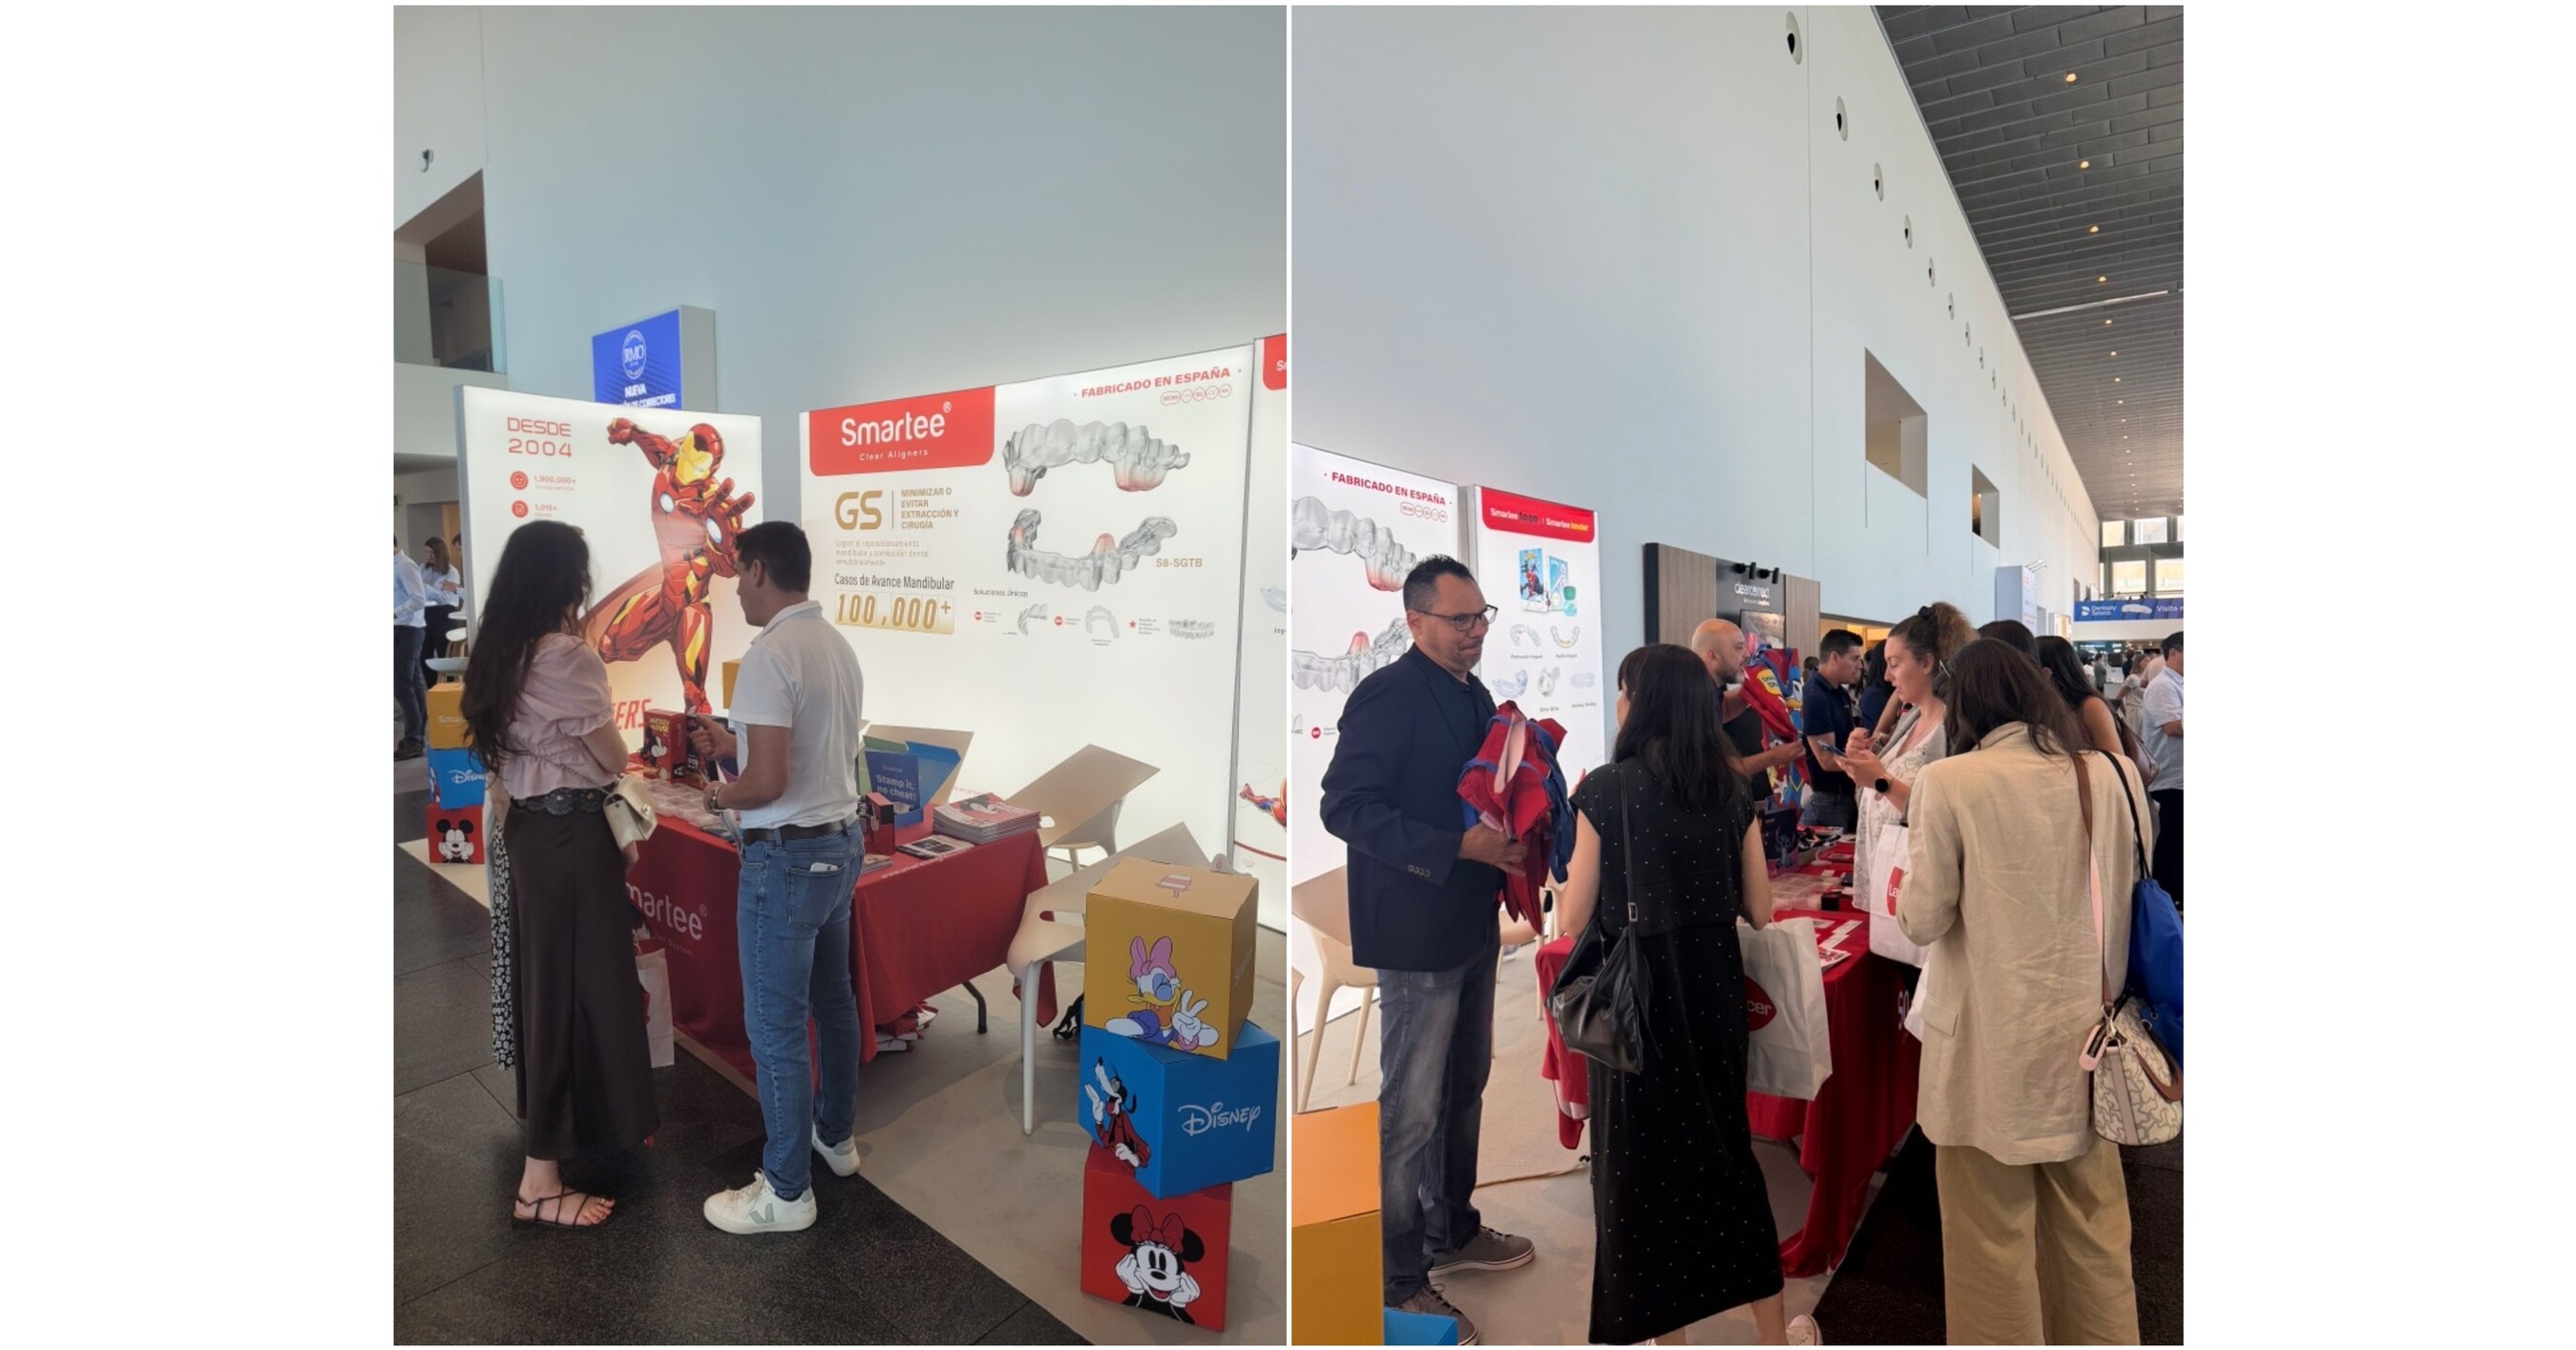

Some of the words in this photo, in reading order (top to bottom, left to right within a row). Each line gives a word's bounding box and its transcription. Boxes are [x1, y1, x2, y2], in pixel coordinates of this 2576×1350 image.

[624, 345, 645, 363] RMO
[624, 383, 647, 398] NUEVA
[1081, 379, 1152, 398] FABRICADO
[1154, 376, 1173, 388] EN
[1175, 367, 1231, 384] ESPAÑA
[507, 416, 572, 437] DESDE
[508, 437, 572, 457] 2004
[859, 453, 884, 461] Clear
[888, 449, 929, 460] Aligners
[900, 488, 945, 497] MINIMIZAR
[945, 487, 953, 496] O
[1331, 471, 1393, 494] FABRICADO
[1394, 485, 1408, 497] EN
[1410, 489, 1446, 506] ESPAÑA
[834, 490, 883, 531] GS
[900, 499, 929, 509] EVITAR
[900, 507, 953, 519] EXTRACCIÓN
[953, 509, 959, 517] Y
[1490, 507, 1518, 521] Smartee
[1545, 517, 1570, 529] Smartee
[900, 520, 934, 530] CIRUGÍA
[834, 573, 858, 586] Casos
[859, 574, 870, 586] de
[871, 575, 902, 588] Avance
[903, 576, 955, 590] Mandibular
[438, 714, 466, 725] Smar
[876, 774, 905, 789] Stamp
[1178, 1101, 1261, 1137] Disney
